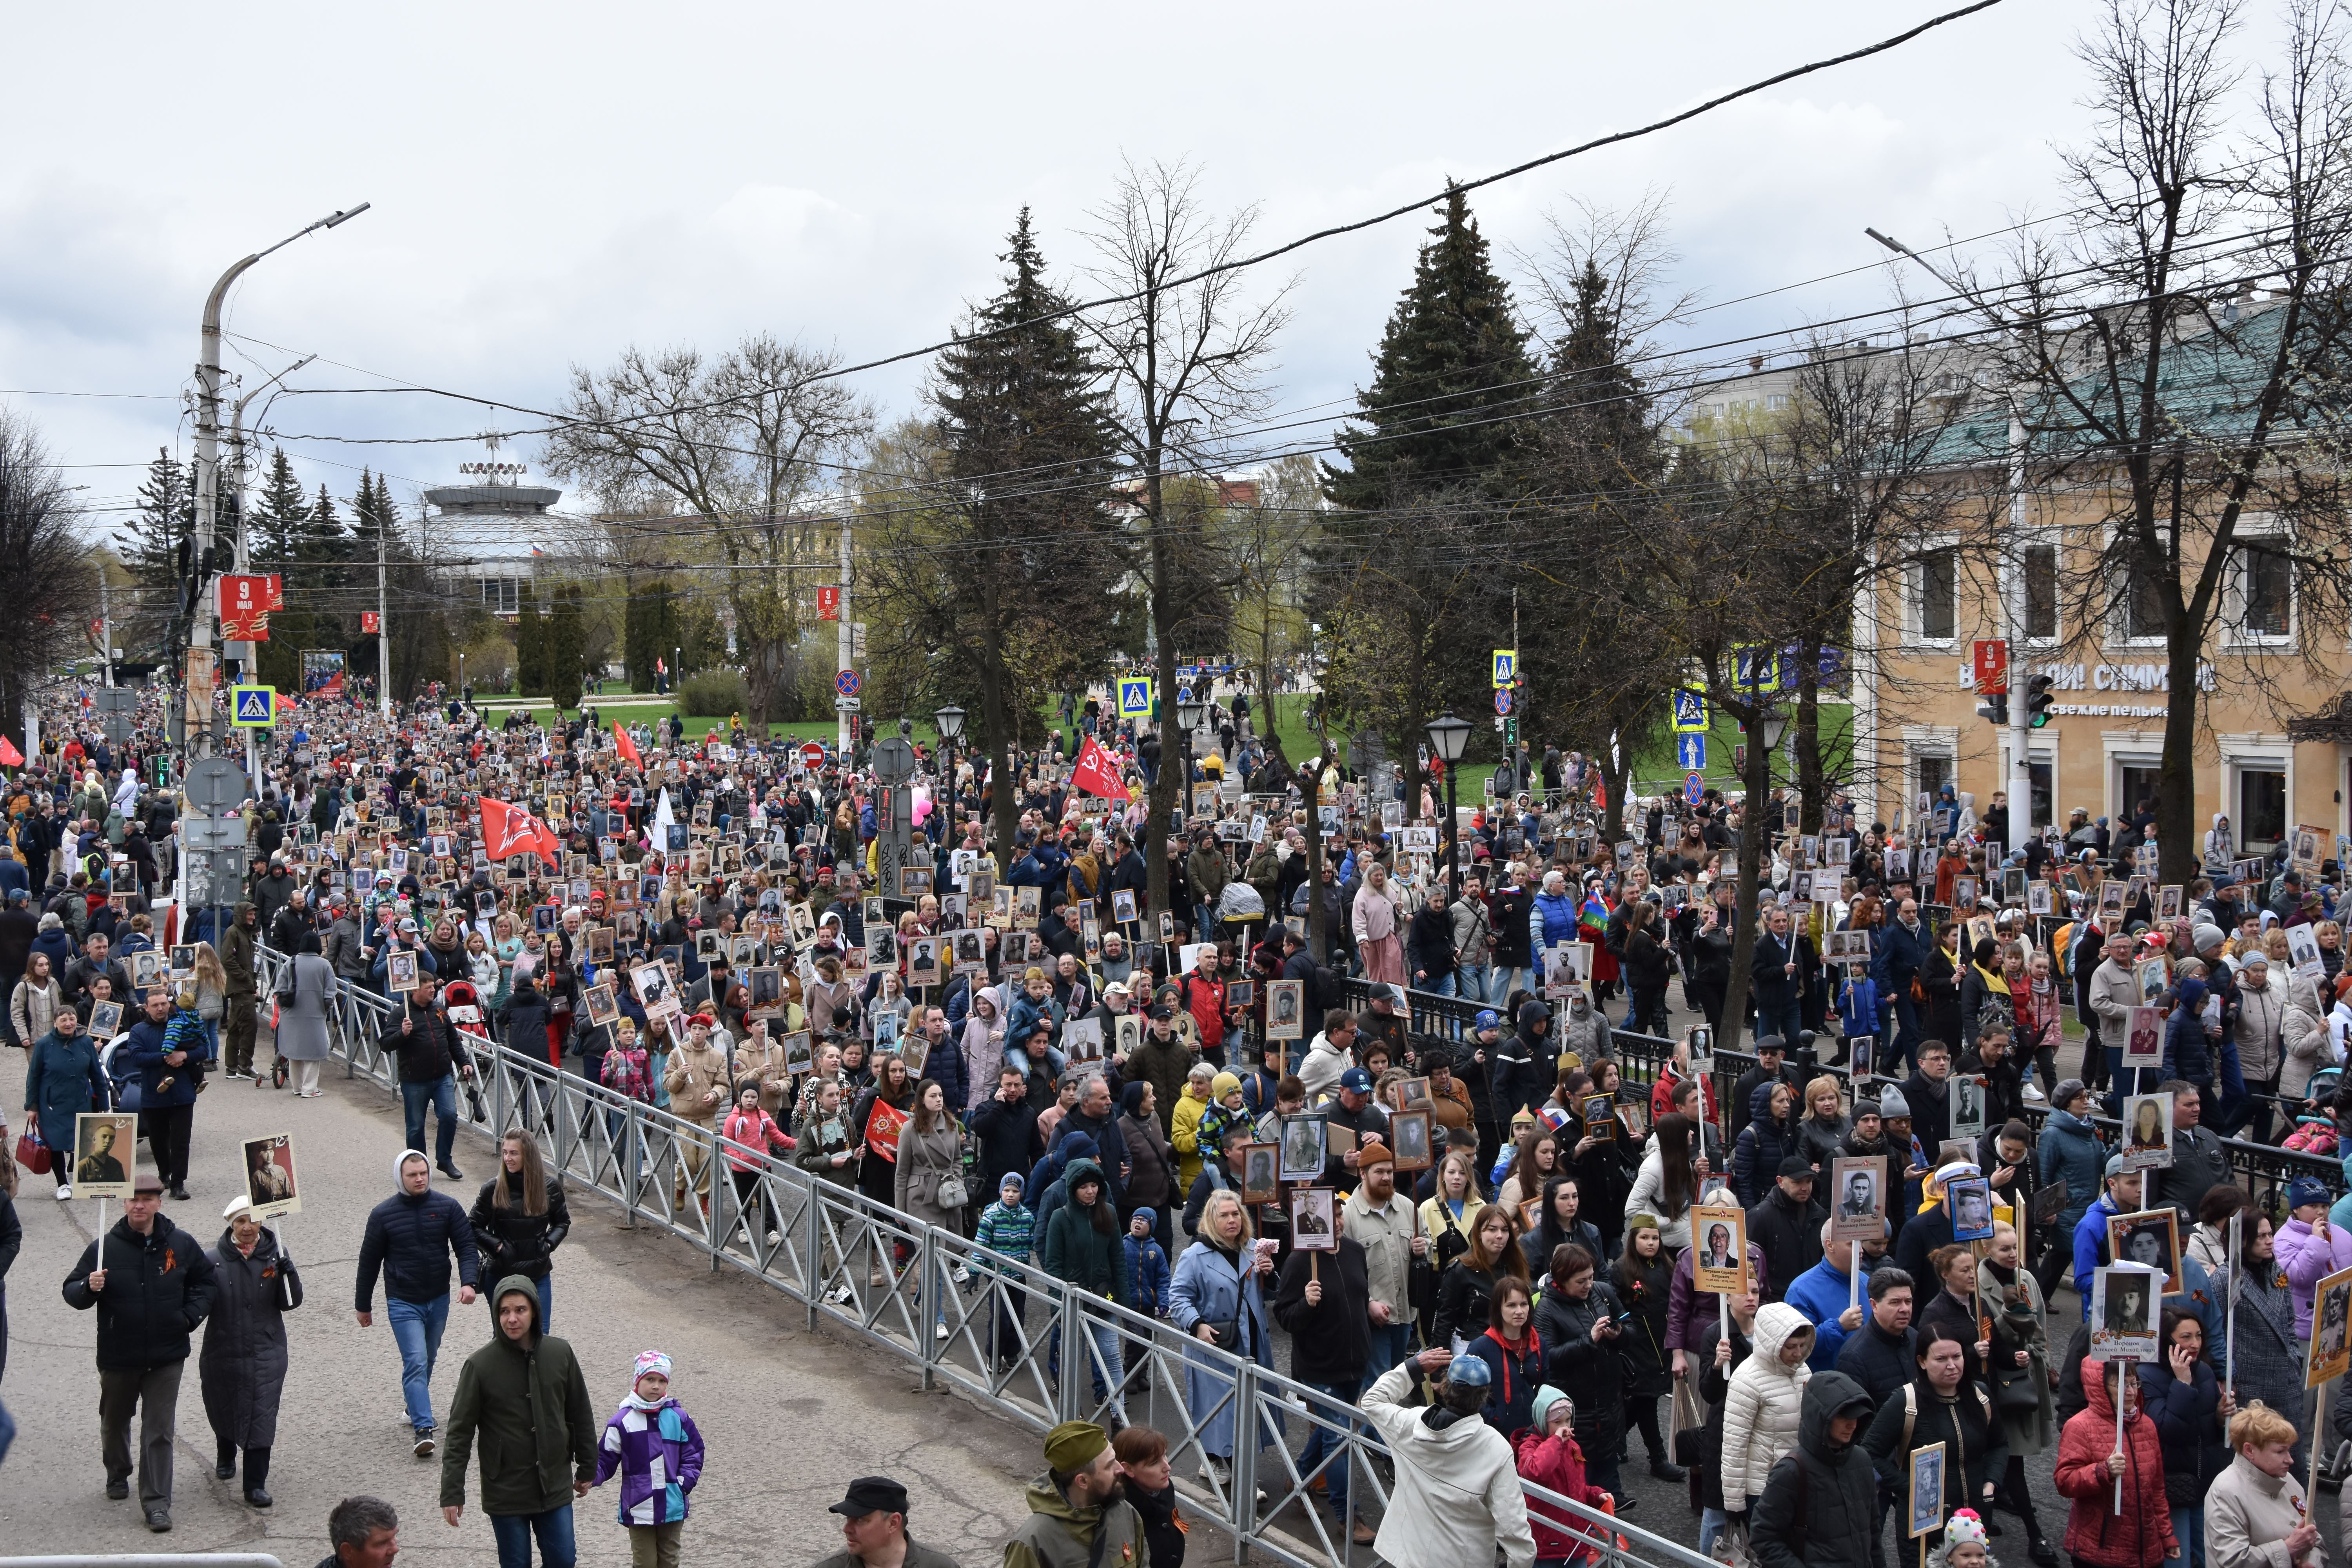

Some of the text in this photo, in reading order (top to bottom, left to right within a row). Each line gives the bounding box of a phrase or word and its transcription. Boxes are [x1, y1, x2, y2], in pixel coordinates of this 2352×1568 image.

[267, 578, 271, 588] 9
[240, 581, 249, 599] 9
[826, 590, 831, 599] 9
[237, 601, 252, 610] МАЯ
[1987, 645, 1994, 660] 9
[2049, 704, 2110, 716] свежие
[1508, 719, 1516, 731] 16
[158, 756, 169, 771] 16
